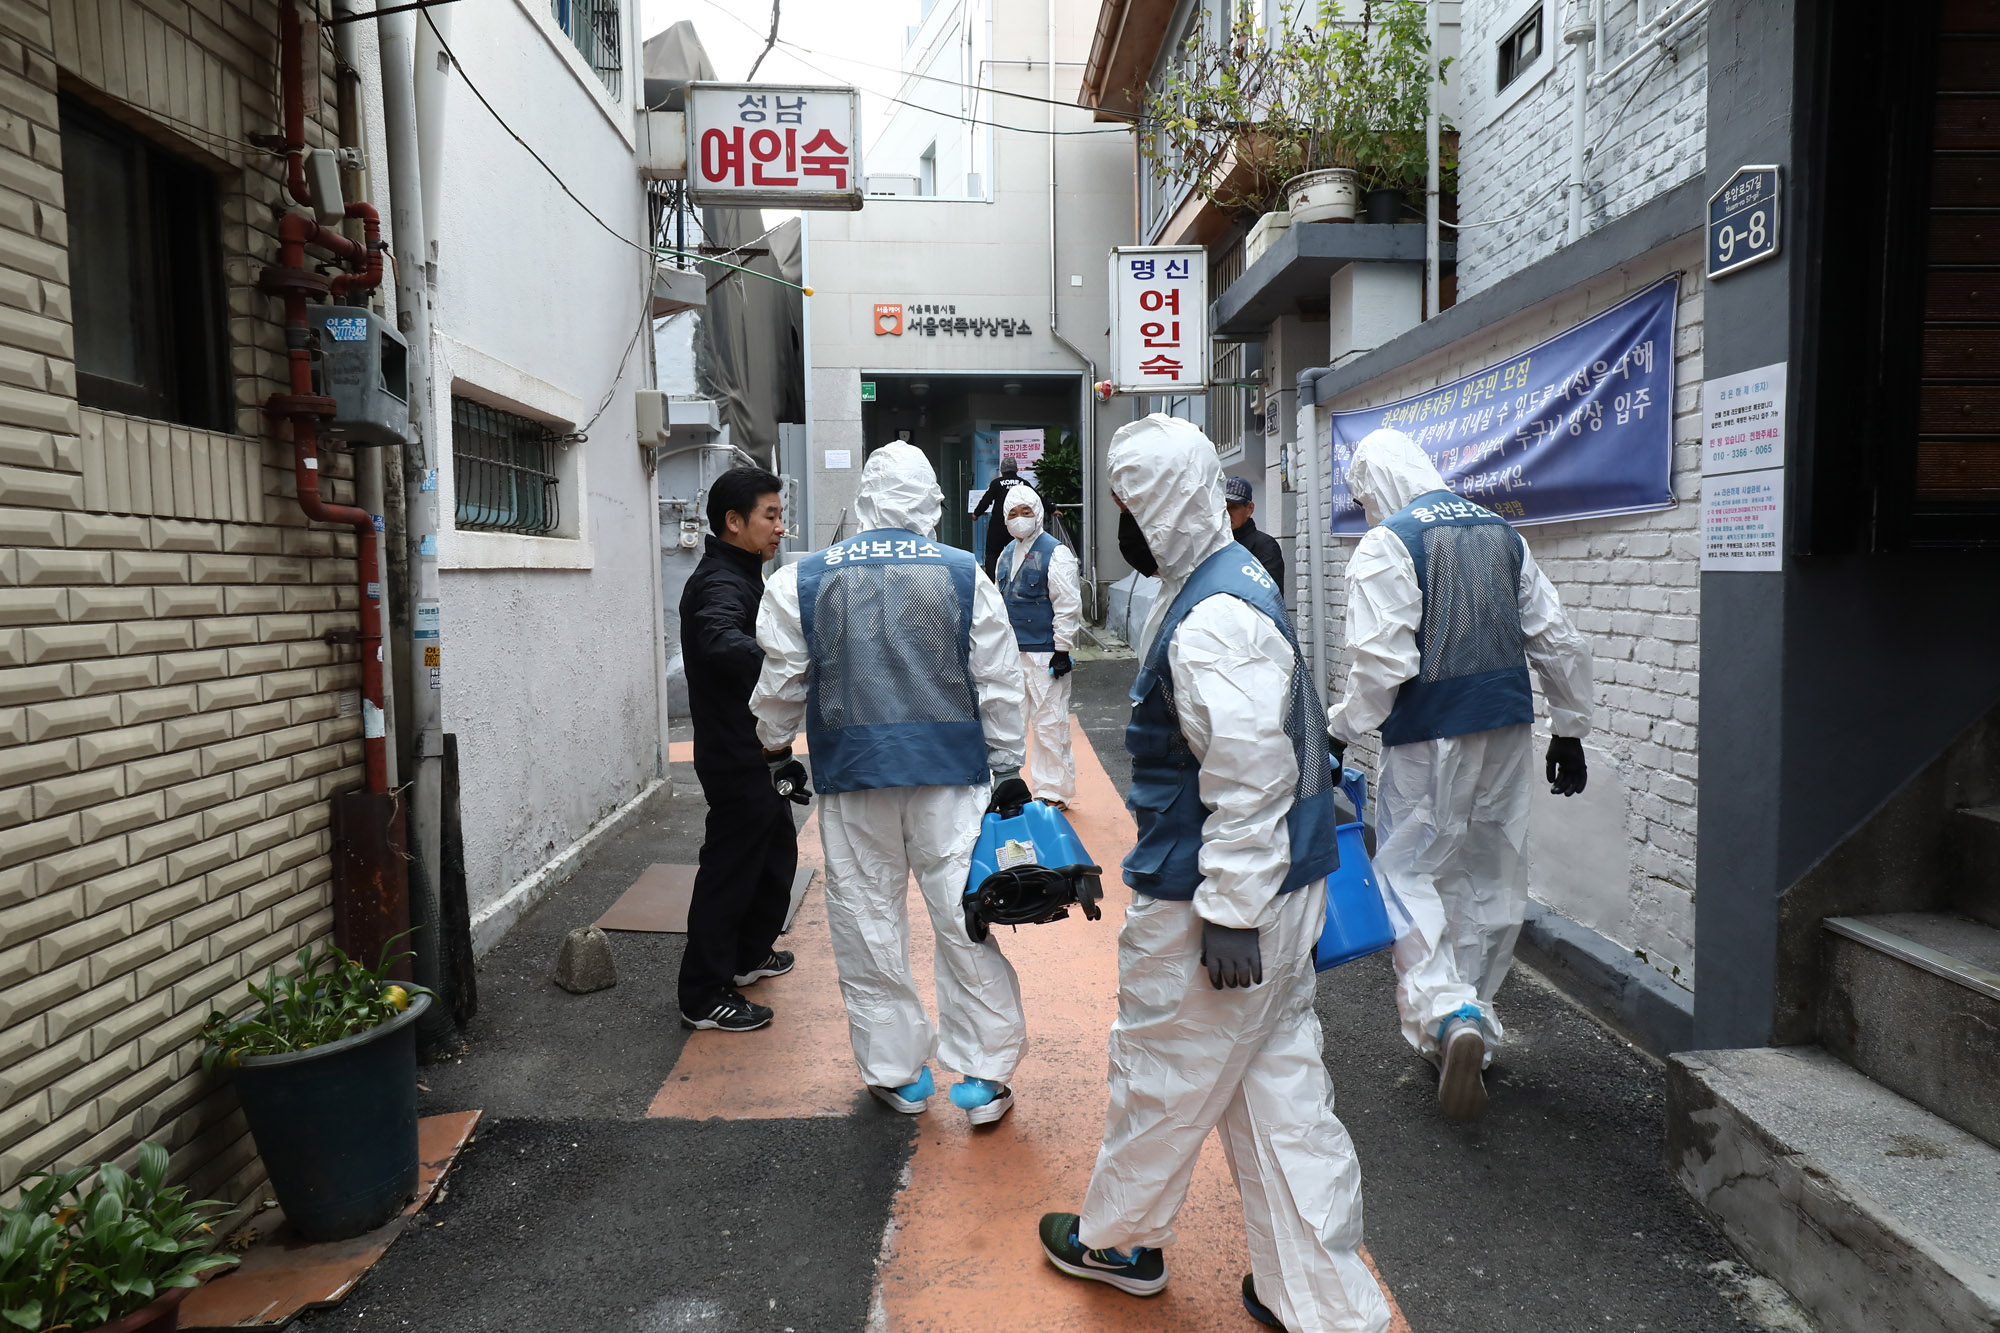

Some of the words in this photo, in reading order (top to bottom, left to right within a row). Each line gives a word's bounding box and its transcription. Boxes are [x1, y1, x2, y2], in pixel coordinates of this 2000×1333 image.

[738, 95, 807, 124] 성남
[701, 126, 849, 189] 여인숙
[1723, 174, 1762, 205] 후암로57길
[1718, 210, 1766, 262] 9-8
[1131, 259, 1189, 280] 명신
[908, 304, 956, 314] 서울특별시립
[907, 317, 1032, 337] 서울역쪽방상담소
[1139, 288, 1183, 380] 여인숙
[1461, 371, 1499, 408] 입주민
[1500, 358, 1532, 392] 모집
[1458, 406, 1495, 436] 지내실
[1496, 401, 1508, 426] 수
[1515, 414, 1562, 452] 누구나
[1614, 387, 1652, 426] 입주
[1003, 444, 1040, 452] 국민기초생활
[1463, 464, 1532, 498] 연락주세요.
[824, 540, 942, 566] 용산보건소
